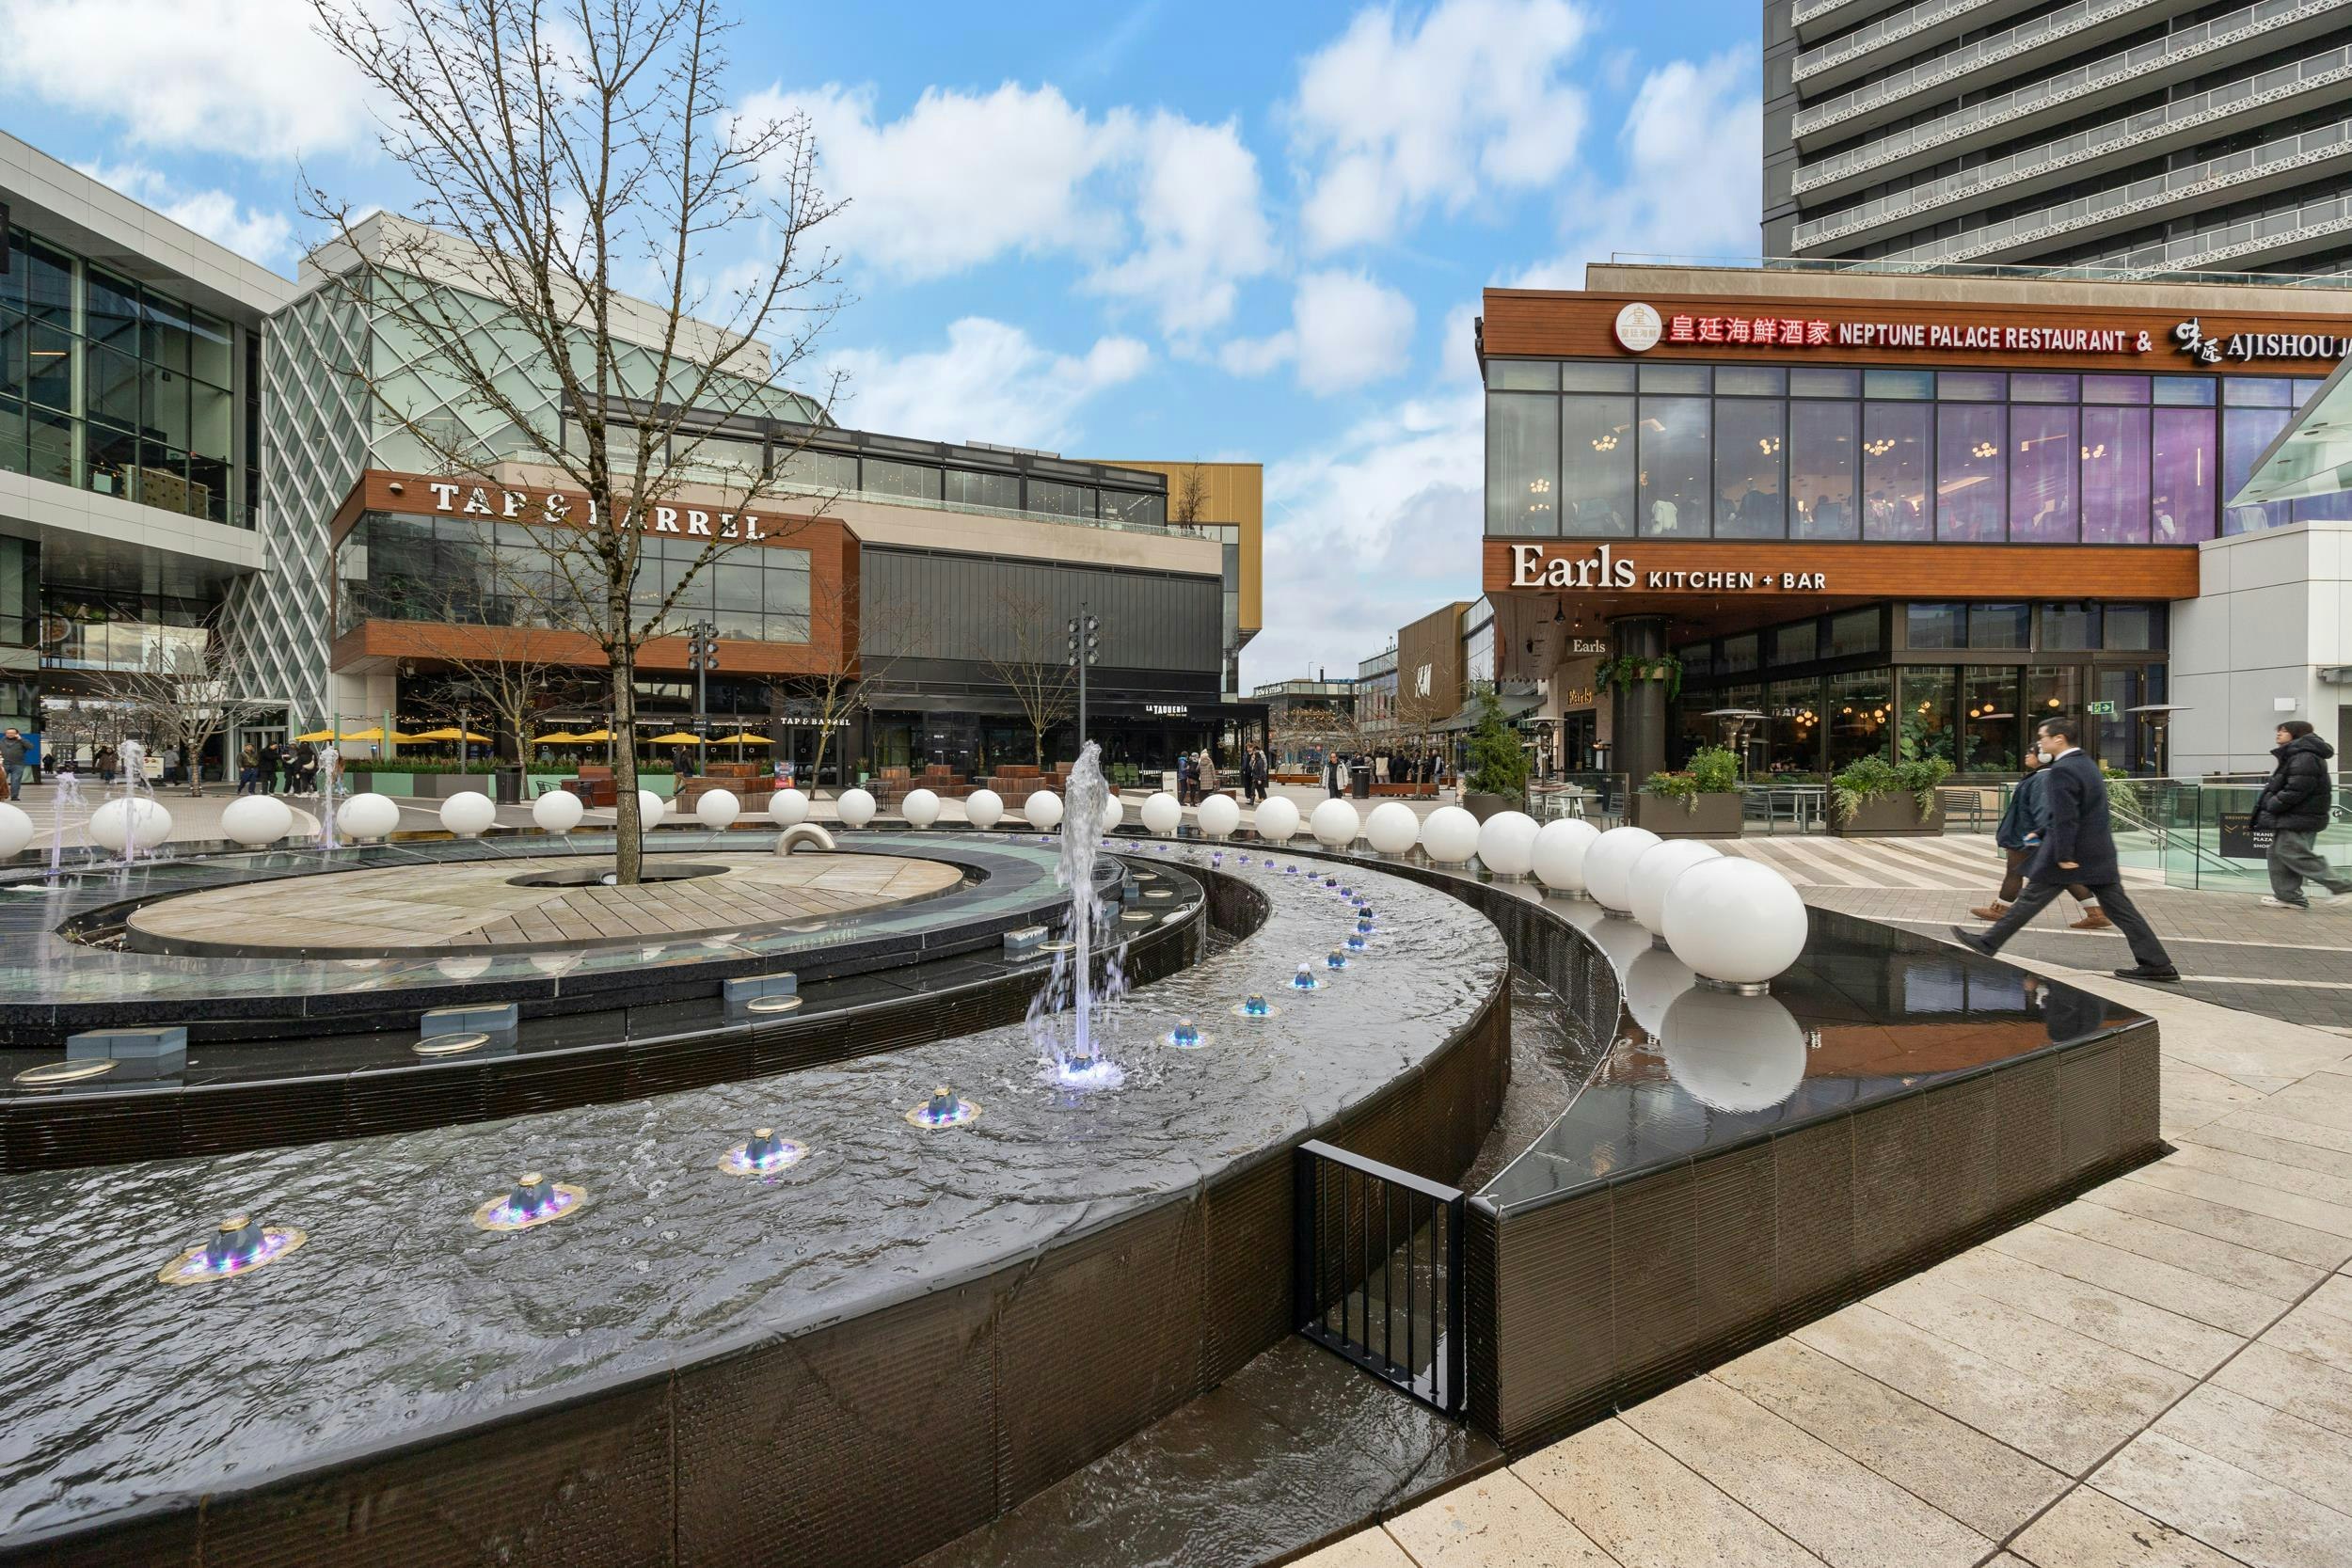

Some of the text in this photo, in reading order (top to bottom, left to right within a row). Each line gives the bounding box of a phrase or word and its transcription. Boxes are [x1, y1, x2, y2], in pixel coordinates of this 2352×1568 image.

[1670, 314, 1830, 344] 皇廷海鮮酒家
[1839, 323, 2153, 352] NEPTUNE PALACE RESTAURANT &
[2227, 333, 2334, 361] AJISHOU
[430, 483, 528, 516] TAP
[543, 494, 572, 522] &
[1511, 544, 1826, 589] Earls KITCHEN + BAR
[1573, 639, 1606, 653] Earls
[1567, 687, 1592, 705] Earls
